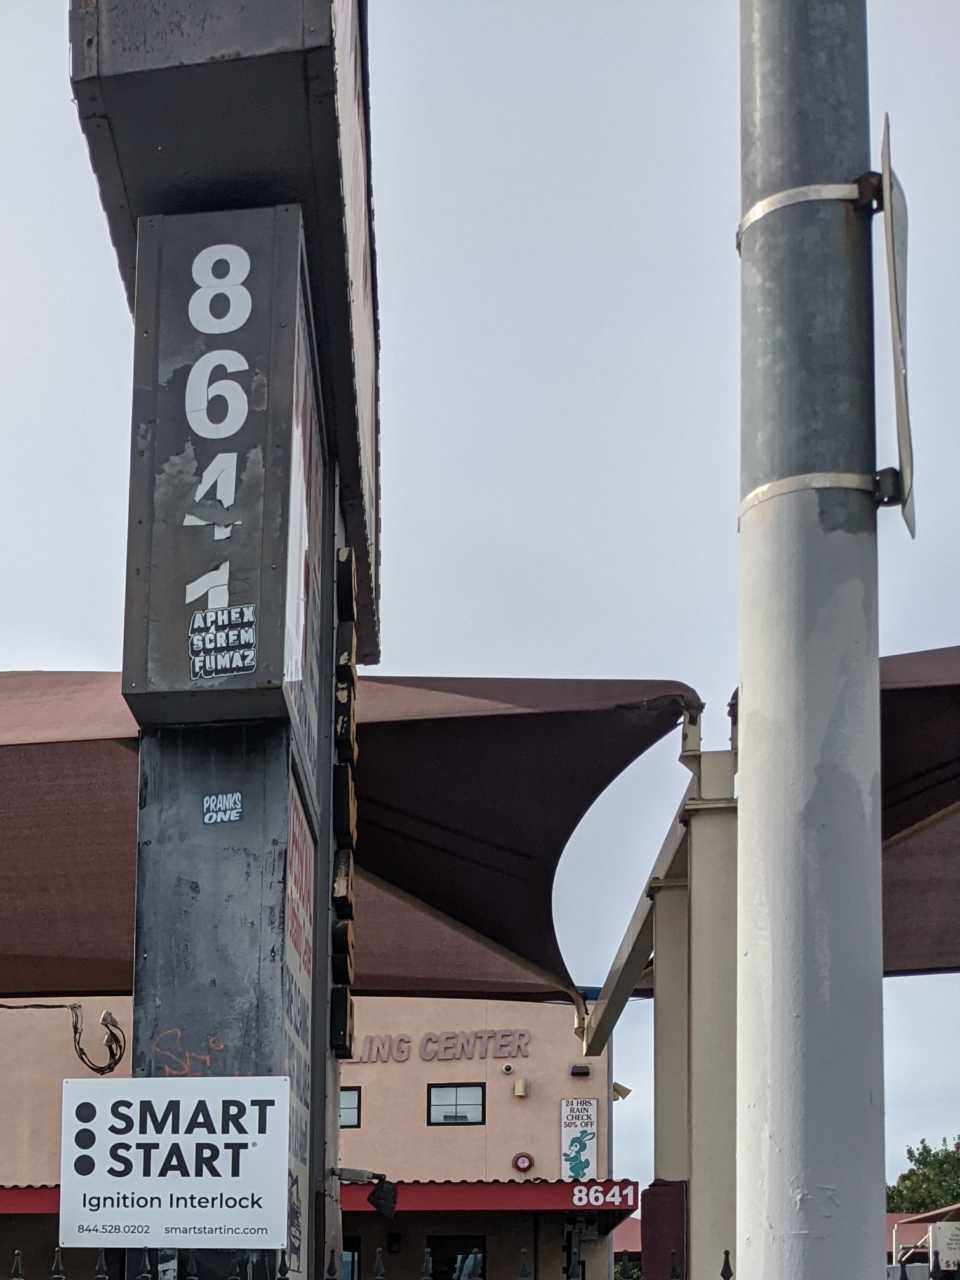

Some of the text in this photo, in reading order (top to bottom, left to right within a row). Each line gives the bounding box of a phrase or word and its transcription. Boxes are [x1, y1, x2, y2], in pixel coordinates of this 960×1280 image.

[193, 606, 255, 629] APHEX
[192, 628, 254, 651] SCREM
[193, 650, 256, 673] FUMAZ
[203, 792, 242, 813] PRANKS
[204, 809, 242, 824] ONE
[419, 1029, 532, 1062] CENTER
[569, 1106, 590, 1114] RAIN
[576, 1099, 593, 1107] HRS
[107, 1099, 276, 1136] SMART
[566, 1113, 593, 1121] CHECK
[580, 1120, 594, 1128] OFF
[106, 1142, 249, 1178] START
[82, 1192, 264, 1213] Ignition Interlock
[572, 1185, 635, 1207] 8641
[77, 1224, 269, 1236] 844.528.0202 smartstartinc.com
